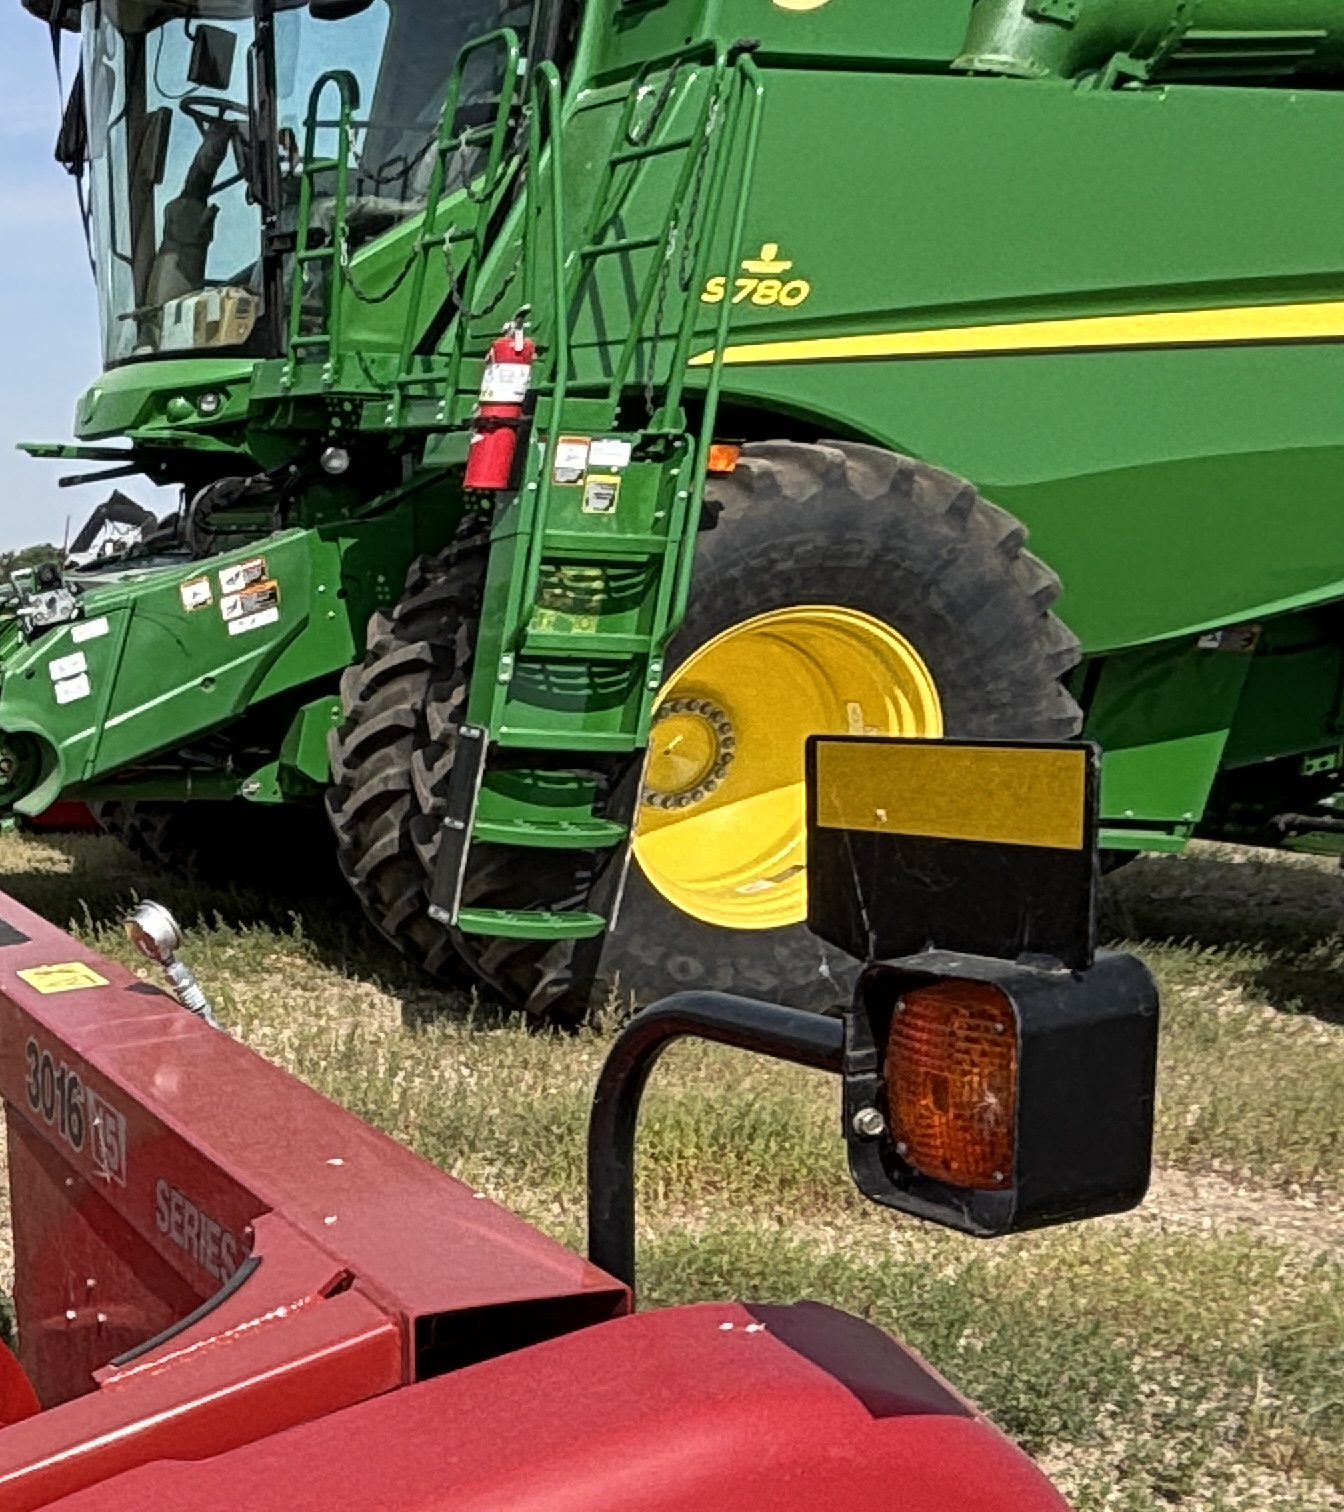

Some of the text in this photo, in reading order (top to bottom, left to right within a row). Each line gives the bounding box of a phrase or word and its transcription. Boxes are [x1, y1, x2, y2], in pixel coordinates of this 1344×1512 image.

[700, 276, 810, 306] S780
[25, 1036, 84, 1154] 3016
[156, 1178, 239, 1287] SERIES
